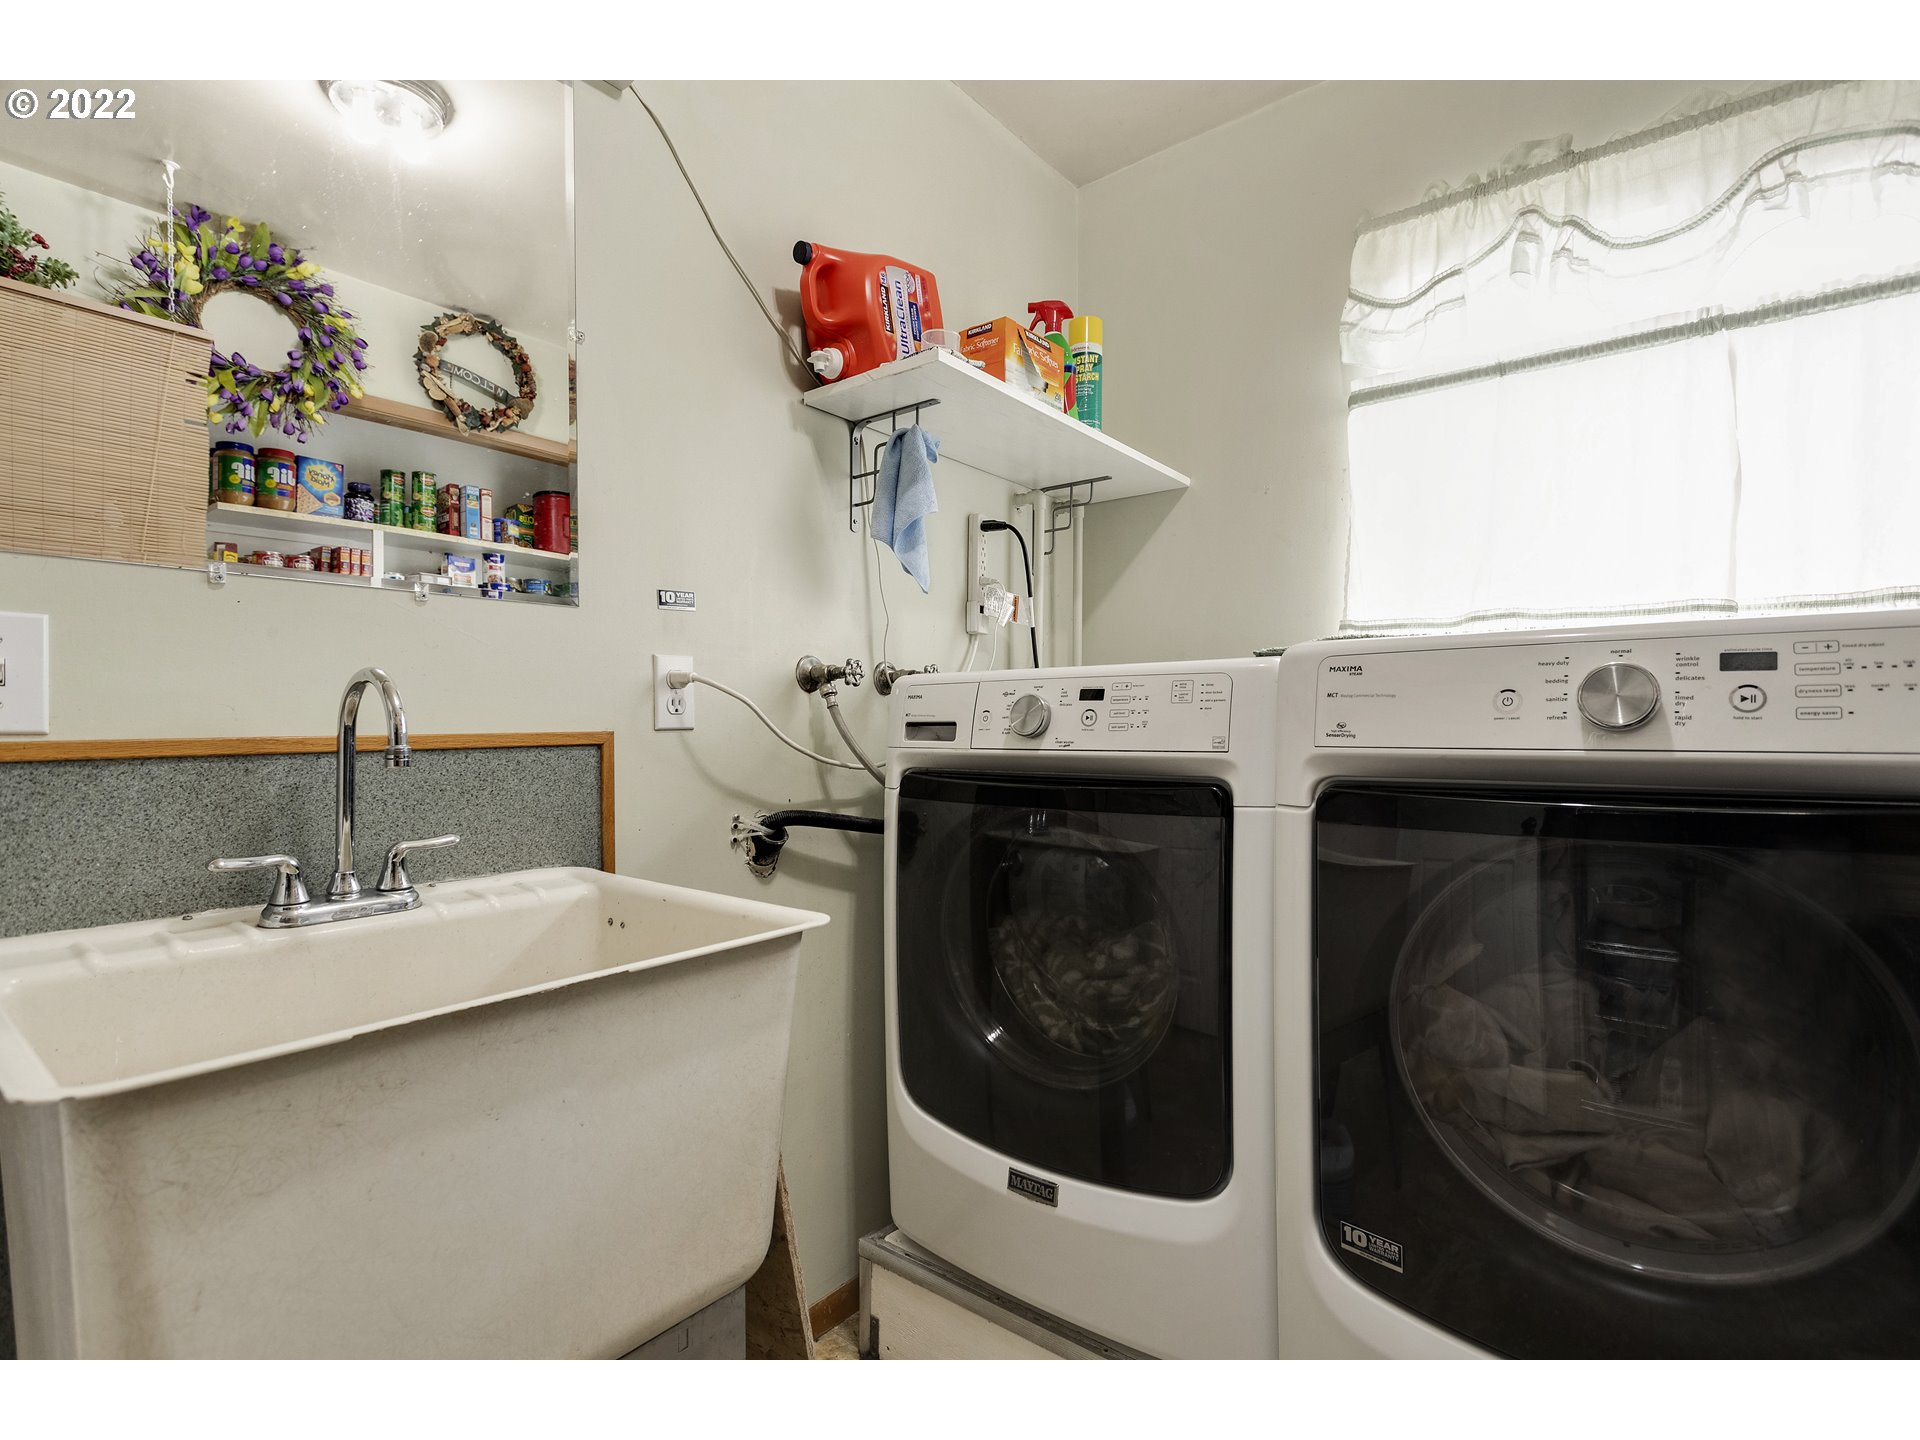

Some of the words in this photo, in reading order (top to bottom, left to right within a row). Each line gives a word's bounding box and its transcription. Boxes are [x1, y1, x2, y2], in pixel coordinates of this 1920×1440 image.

[881, 286, 891, 332] KIRKLAND
[895, 280, 910, 355] UltraClean
[968, 323, 992, 336] KIRKLAND
[1025, 330, 1051, 349] KIRKLAND
[1075, 354, 1099, 364] STANT
[1076, 363, 1094, 372] PRAY
[660, 591, 676, 603] 10
[1011, 1175, 1053, 1199] MAYTAG
[1344, 1225, 1367, 1248] 10
[1369, 1235, 1399, 1253] YEAR
